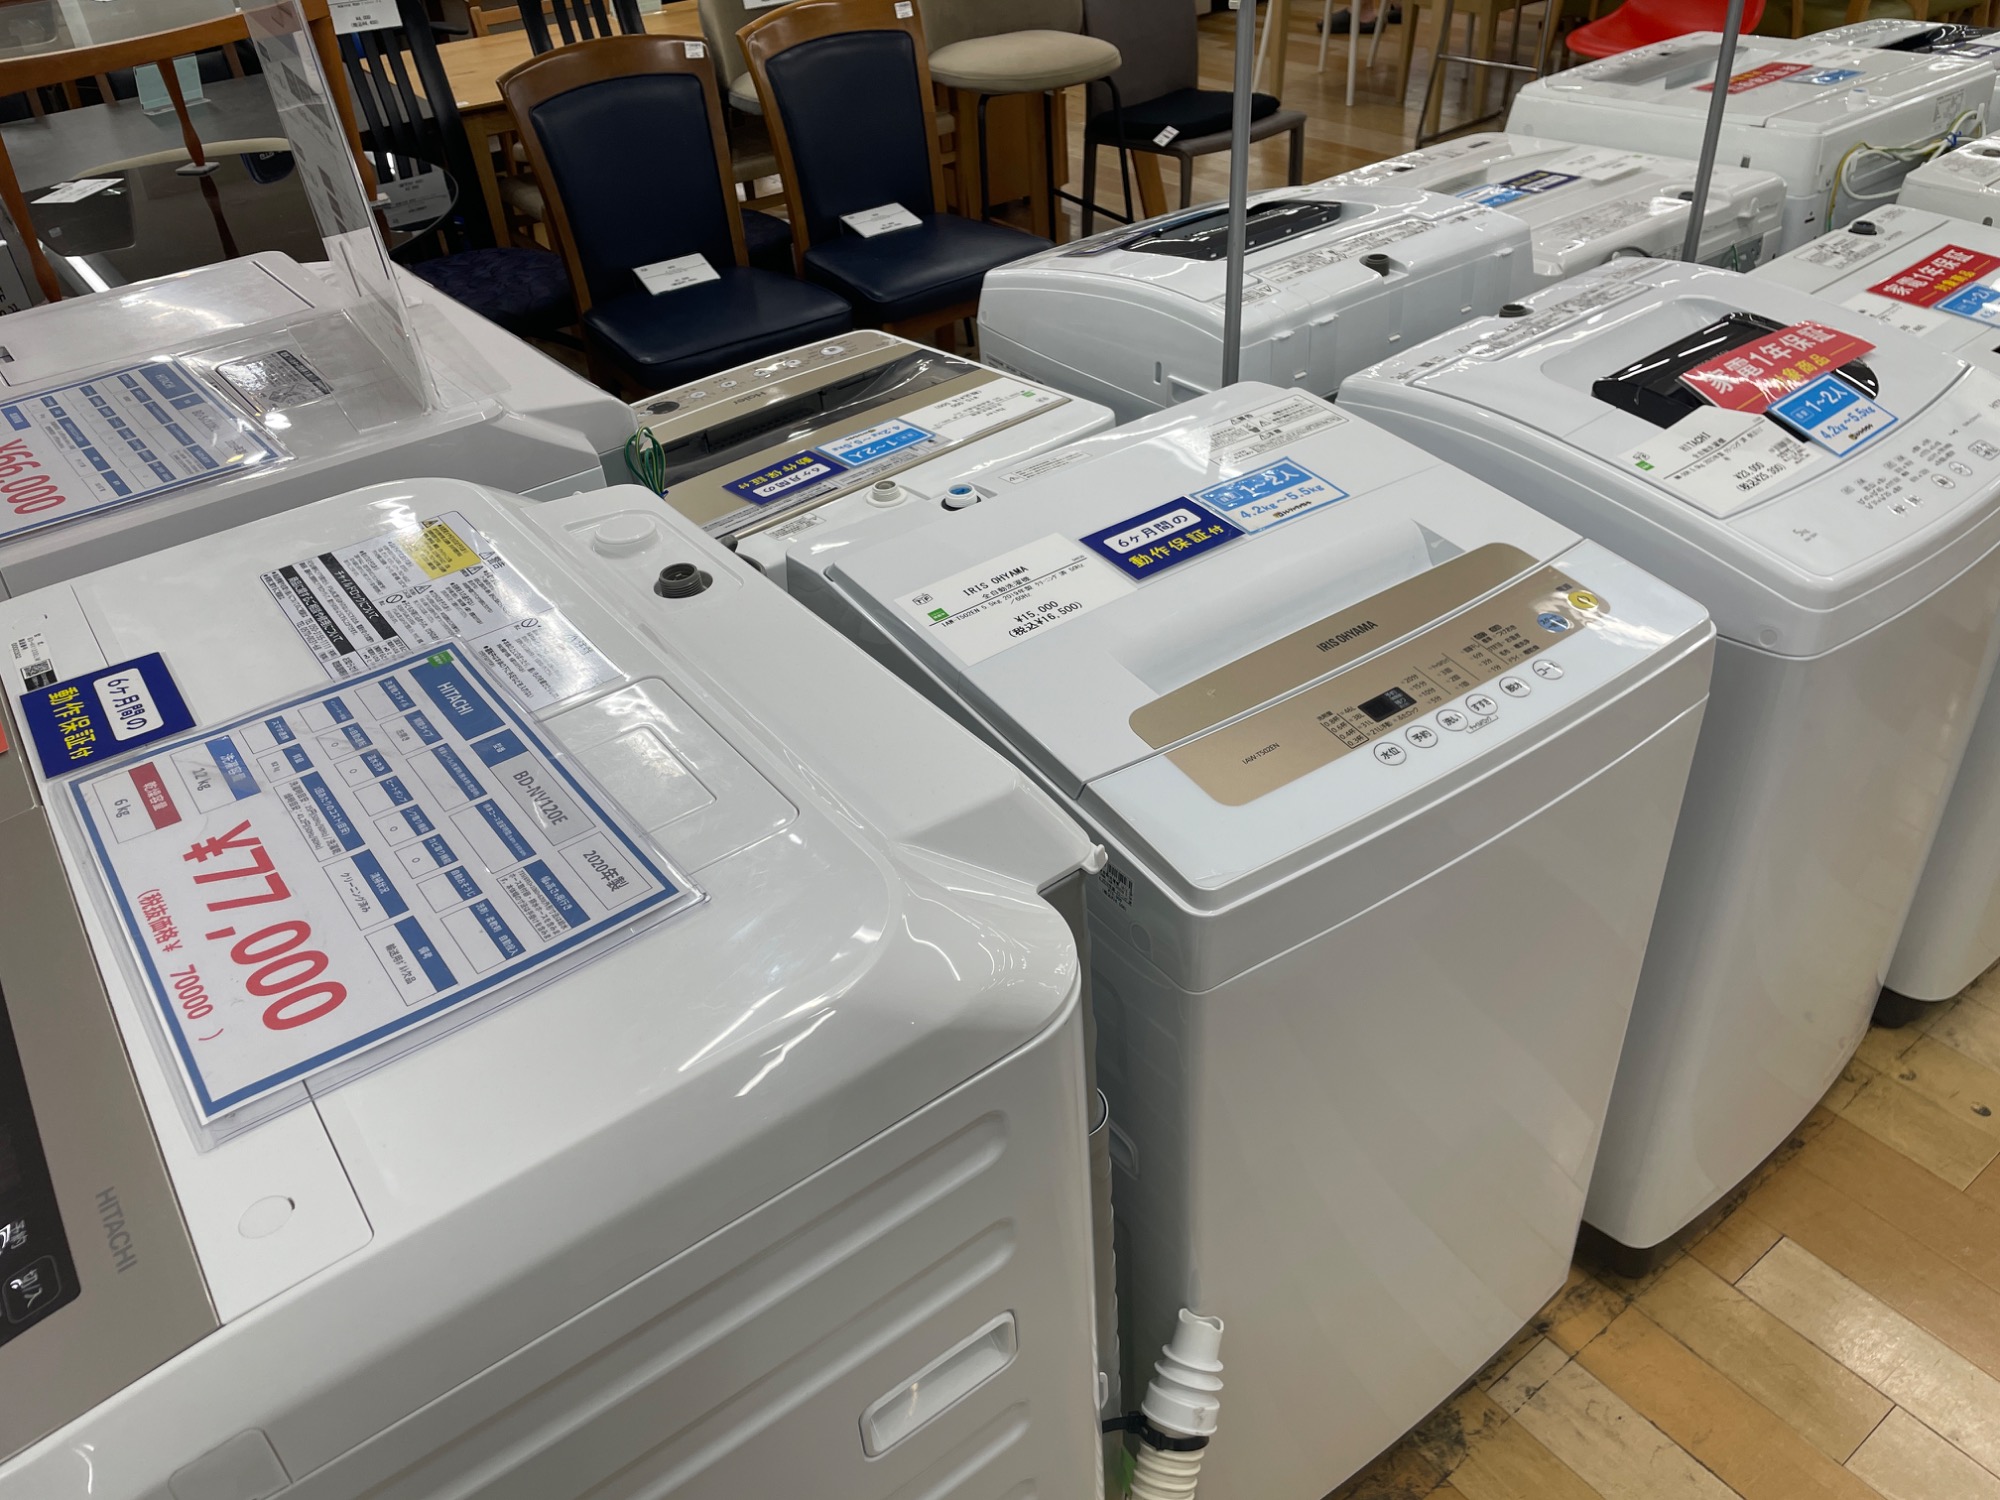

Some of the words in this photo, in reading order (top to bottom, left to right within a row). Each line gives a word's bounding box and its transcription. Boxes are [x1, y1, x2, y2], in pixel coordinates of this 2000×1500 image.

[1883, 249, 1975, 296] 家電1年保証
[1704, 324, 1837, 394] 家電1年保証
[733, 390, 768, 407] Haier
[1678, 432, 1712, 454] HITACHI
[737, 456, 813, 490] 動作保証付
[1118, 515, 1188, 547] 6ヶ月間の
[1129, 525, 1224, 568] 動作保証付
[337, 568, 380, 621] チャイルドロックについて
[963, 582, 989, 596] IRIS
[991, 566, 1028, 584] OHYAMA
[982, 576, 1030, 603] 全自動洗濯機
[1009, 602, 1082, 637] (税込¥16,500)
[1014, 601, 1058, 628] ¥15,000
[1316, 636, 1340, 652] IRIS
[1336, 621, 1378, 643] OHYAMA
[107, 678, 147, 730] 6ヶ月間の
[1471, 698, 1492, 712] すすぎ
[49, 687, 96, 759] 動作保証付
[1442, 713, 1462, 726] 洗い
[1412, 730, 1432, 742] 予約
[220, 753, 246, 782] 洗濯容量
[1380, 746, 1400, 760] 水位
[192, 768, 208, 780] 12
[197, 778, 211, 791] kg
[437, 682, 474, 715] HITACHI
[513, 770, 568, 825] BD-NV120E
[583, 850, 629, 892] 2020年製
[116, 804, 131, 818] kg
[143, 781, 168, 811] 乾燥容量
[340, 872, 371, 913] クリーニング済み
[450, 869, 476, 897] 自動おそうじ
[184, 821, 346, 1030] ¥77,000
[418, 946, 433, 959] 備考
[499, 935, 518, 956] 自動投入
[170, 964, 213, 1019] 70000
[95, 1186, 138, 1274] HITACHI
